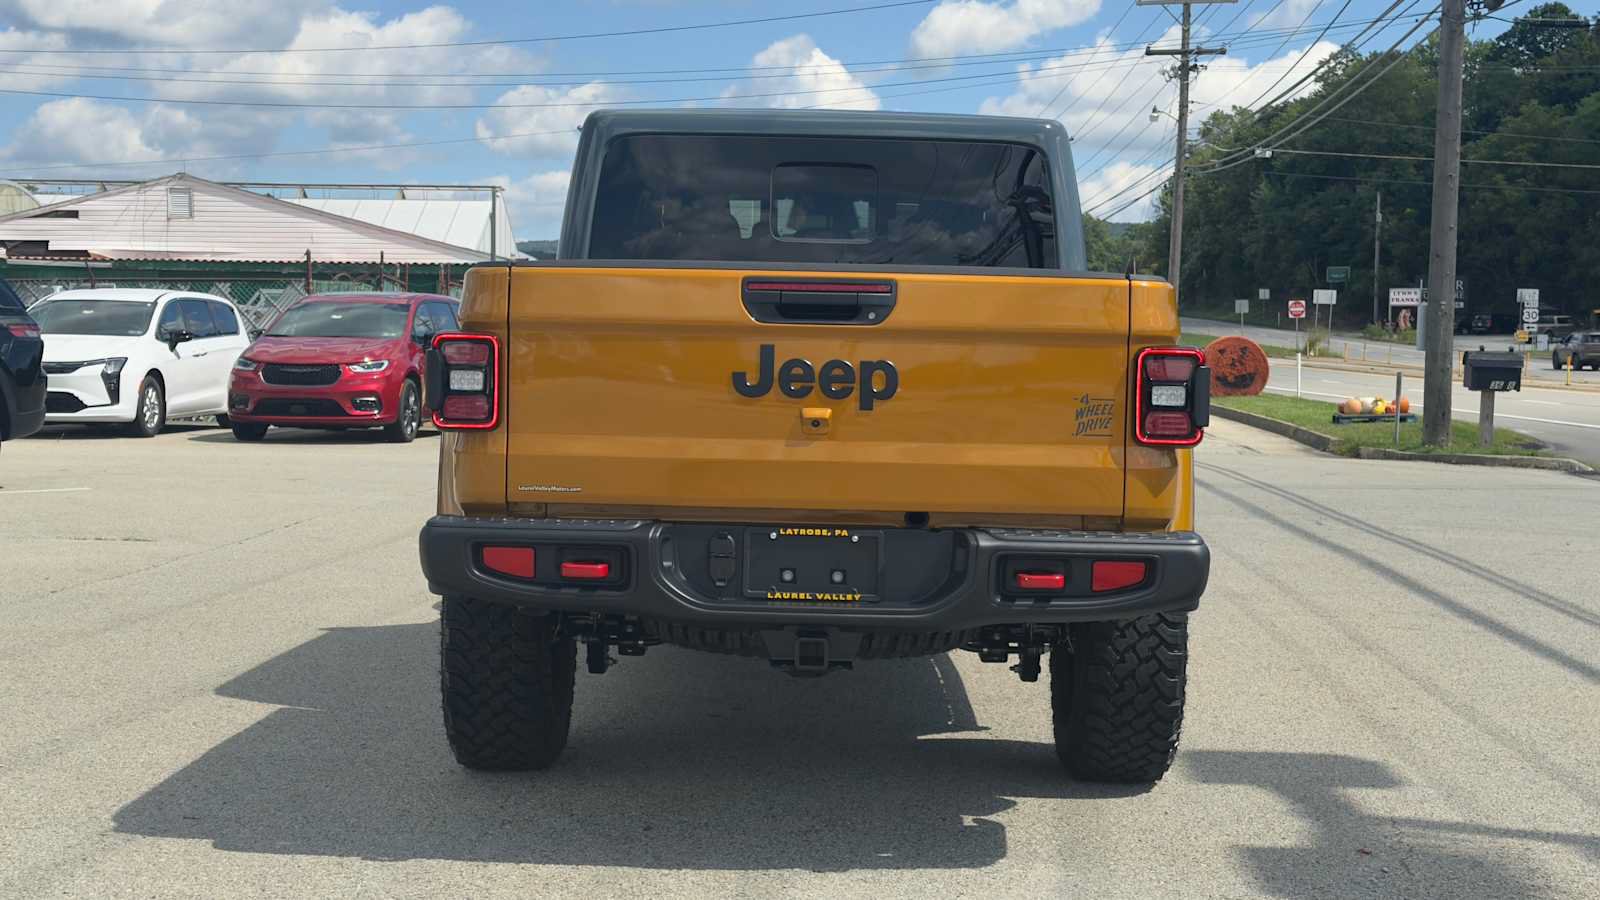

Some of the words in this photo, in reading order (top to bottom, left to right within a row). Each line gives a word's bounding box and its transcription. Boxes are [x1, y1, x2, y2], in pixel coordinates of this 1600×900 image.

[1525, 311, 1538, 320] 30
[732, 344, 898, 411] Jeep
[1080, 393, 1089, 405] 4
[1075, 403, 1114, 420] WHEEL
[1075, 417, 1113, 434] DRIVE
[779, 528, 831, 536] LATROBE,
[834, 529, 849, 537] PA
[767, 592, 812, 600] LAUREL
[815, 593, 862, 601] VALLEY
